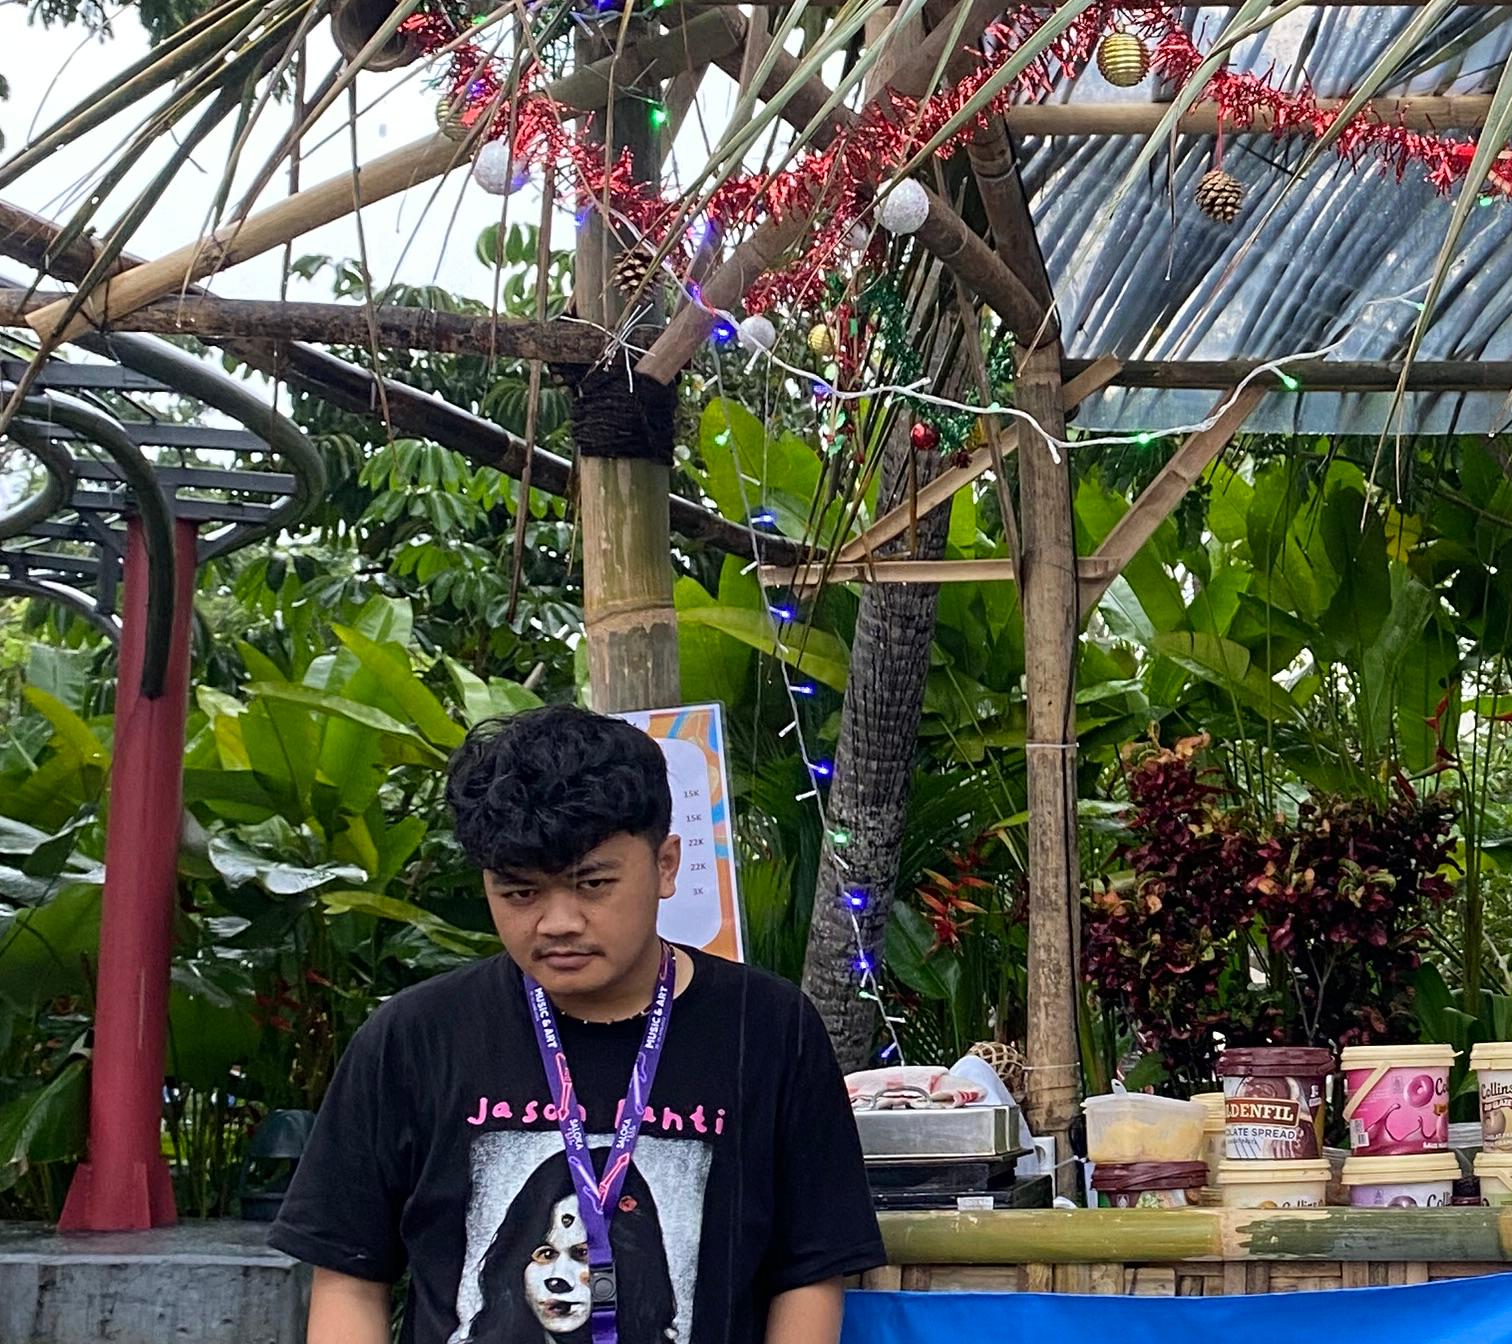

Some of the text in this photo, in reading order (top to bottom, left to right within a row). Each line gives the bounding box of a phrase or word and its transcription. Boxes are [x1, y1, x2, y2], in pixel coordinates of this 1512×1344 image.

[535, 987, 549, 1018] MUSIC
[544, 1028, 558, 1049] ART
[645, 1017, 661, 1049] MUSIC
[656, 986, 668, 1006] ART
[616, 1118, 632, 1149] SALOKA
[1251, 1128, 1295, 1139] SPREAD
